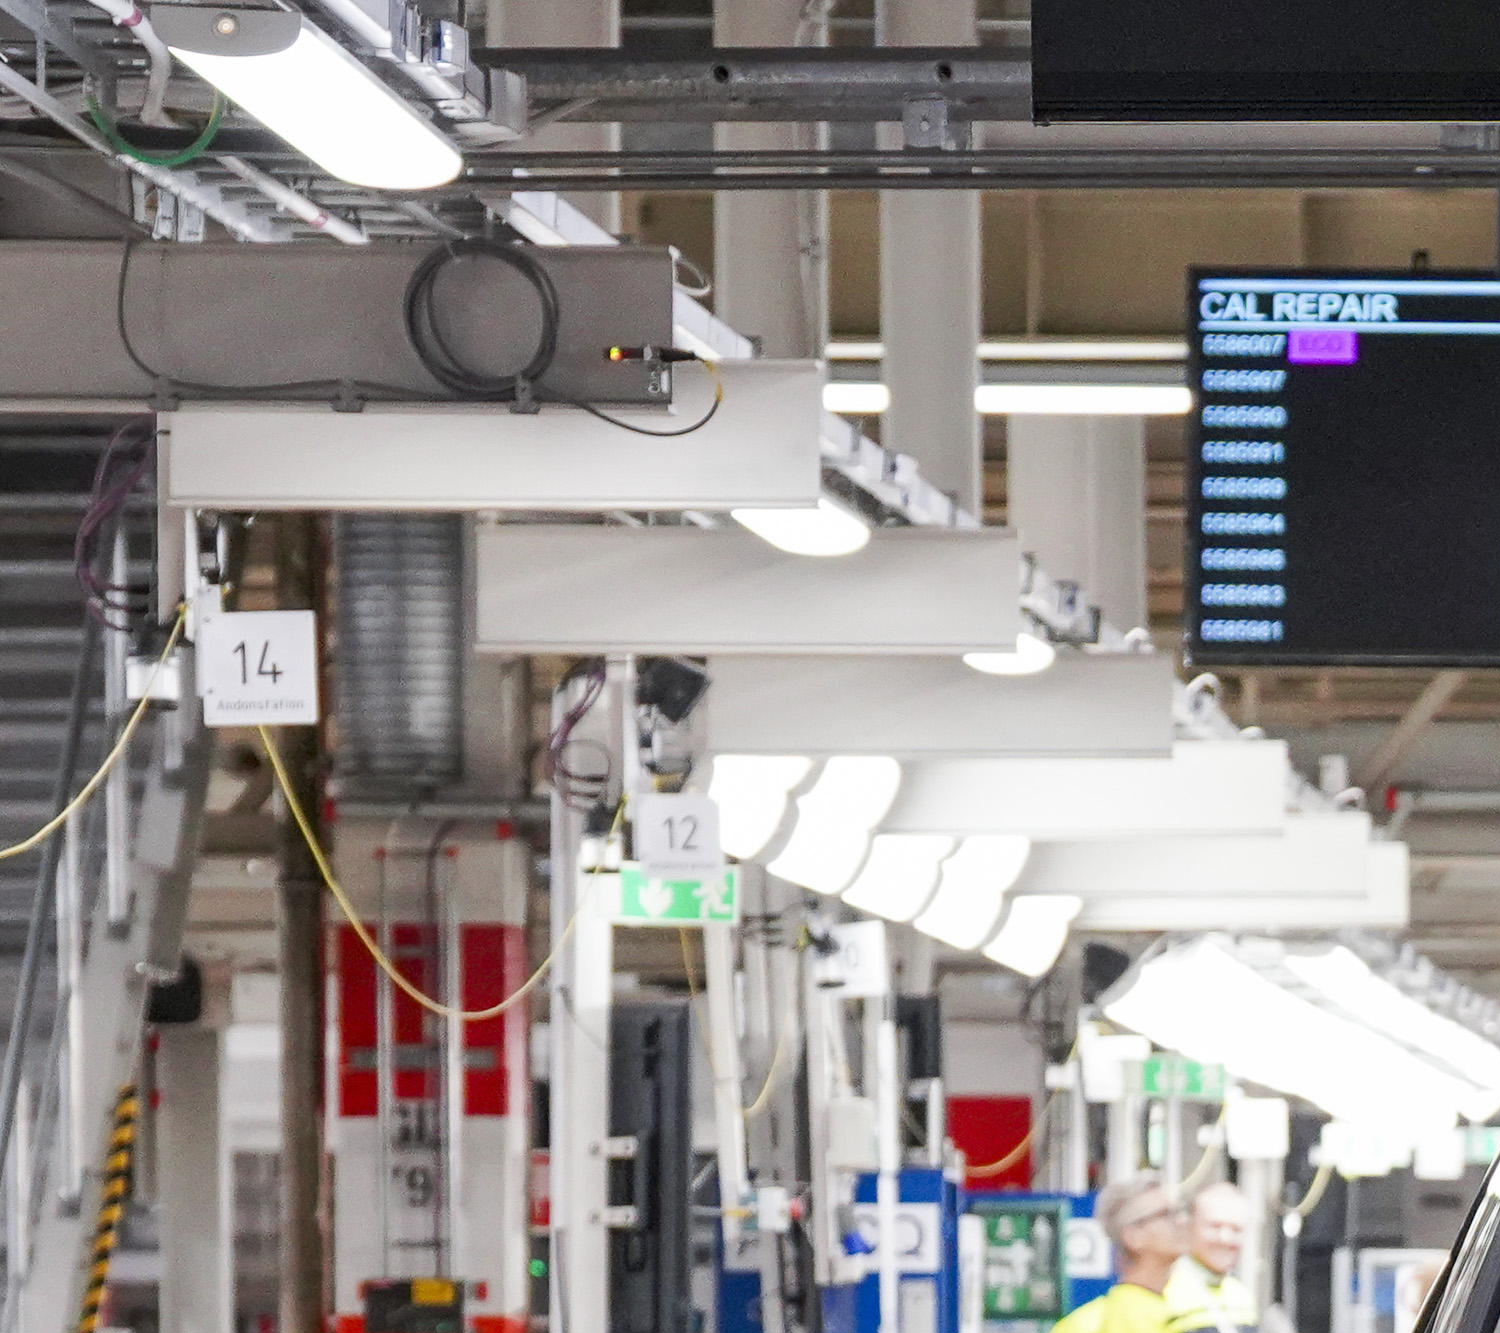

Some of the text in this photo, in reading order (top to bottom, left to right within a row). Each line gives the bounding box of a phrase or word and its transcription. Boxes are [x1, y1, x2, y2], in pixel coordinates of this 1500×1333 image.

[1200, 291, 1399, 322] CAL REPAIR
[232, 639, 284, 685] 14
[662, 815, 699, 850] 12
